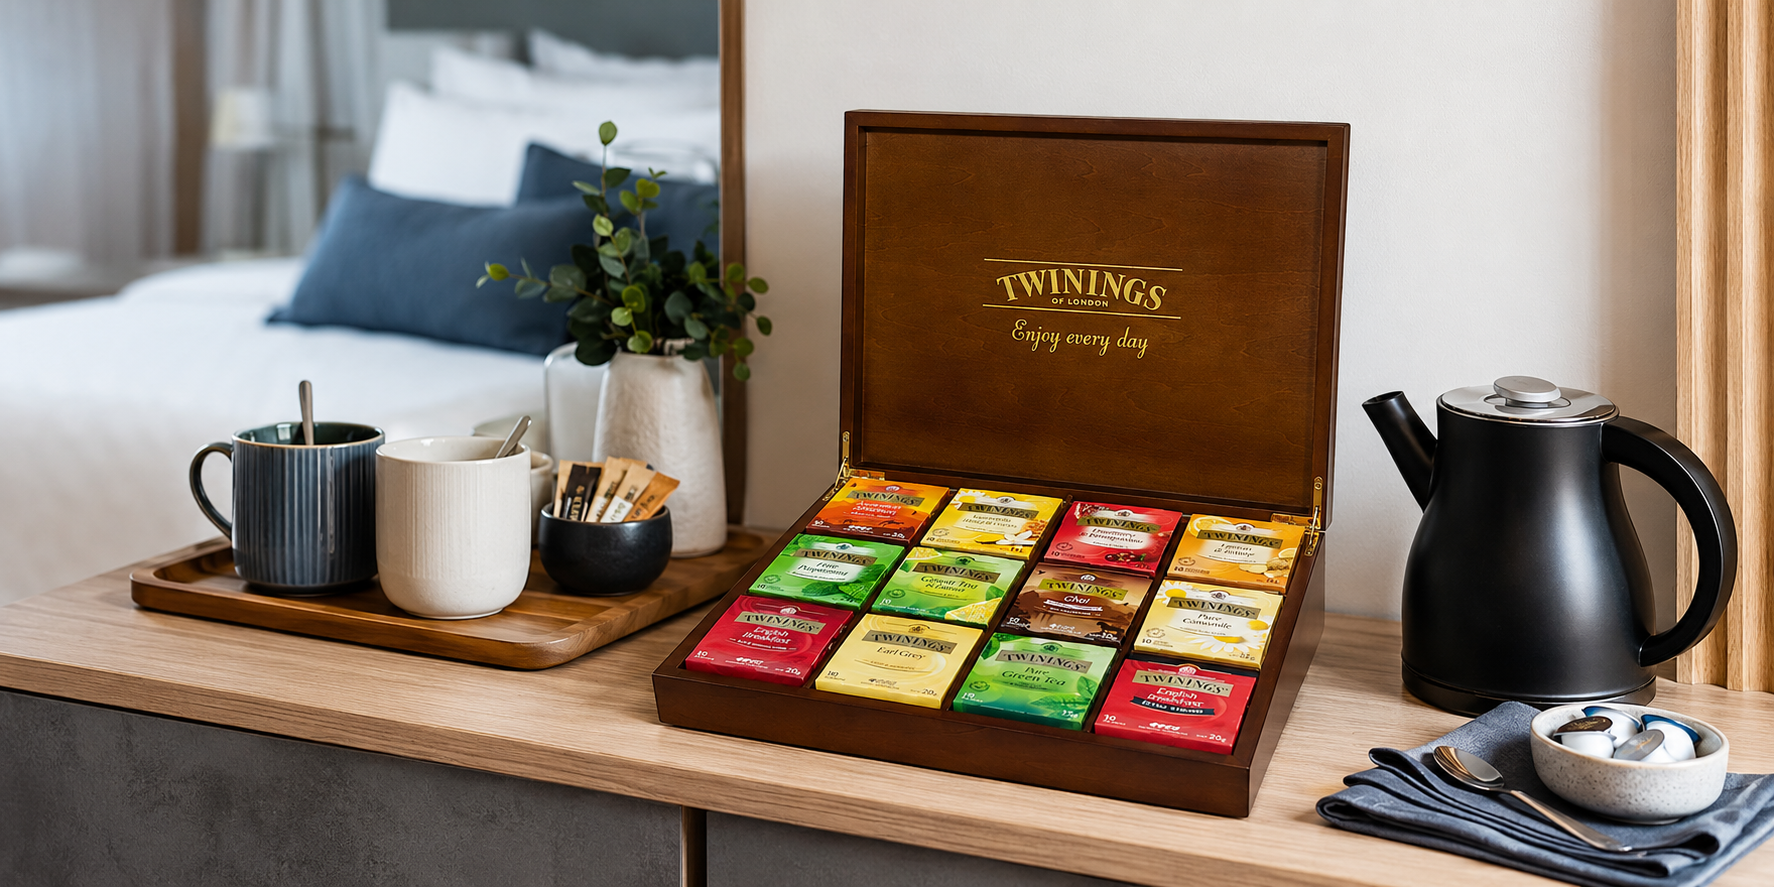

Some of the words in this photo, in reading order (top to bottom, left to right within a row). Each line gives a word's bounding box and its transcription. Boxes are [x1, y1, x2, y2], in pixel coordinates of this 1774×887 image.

[996, 268, 1167, 311] TWININGS
[1051, 297, 1064, 305] OF
[1068, 298, 1109, 307] LONDON
[1011, 319, 1061, 353] Enjoy
[1066, 332, 1111, 356] every
[1116, 326, 1149, 359] day
[855, 492, 916, 506] TWININGS
[1204, 532, 1278, 547] TWININGS
[802, 550, 872, 566] TWININGS
[922, 564, 994, 581] TWININGS
[1046, 582, 1122, 597] TWININGS
[1064, 595, 1091, 604] Chai
[1174, 600, 1255, 617] TWININGS
[744, 614, 819, 633] TWININGS
[871, 633, 951, 652] TWININGS
[877, 646, 898, 656] Earl
[899, 650, 924, 661] Grey
[1003, 653, 1086, 671] TWININGS
[1001, 671, 1041, 682] Green
[1042, 676, 1066, 686] Tea
[1140, 674, 1228, 694] TWININGS
[1156, 687, 1198, 700] English
